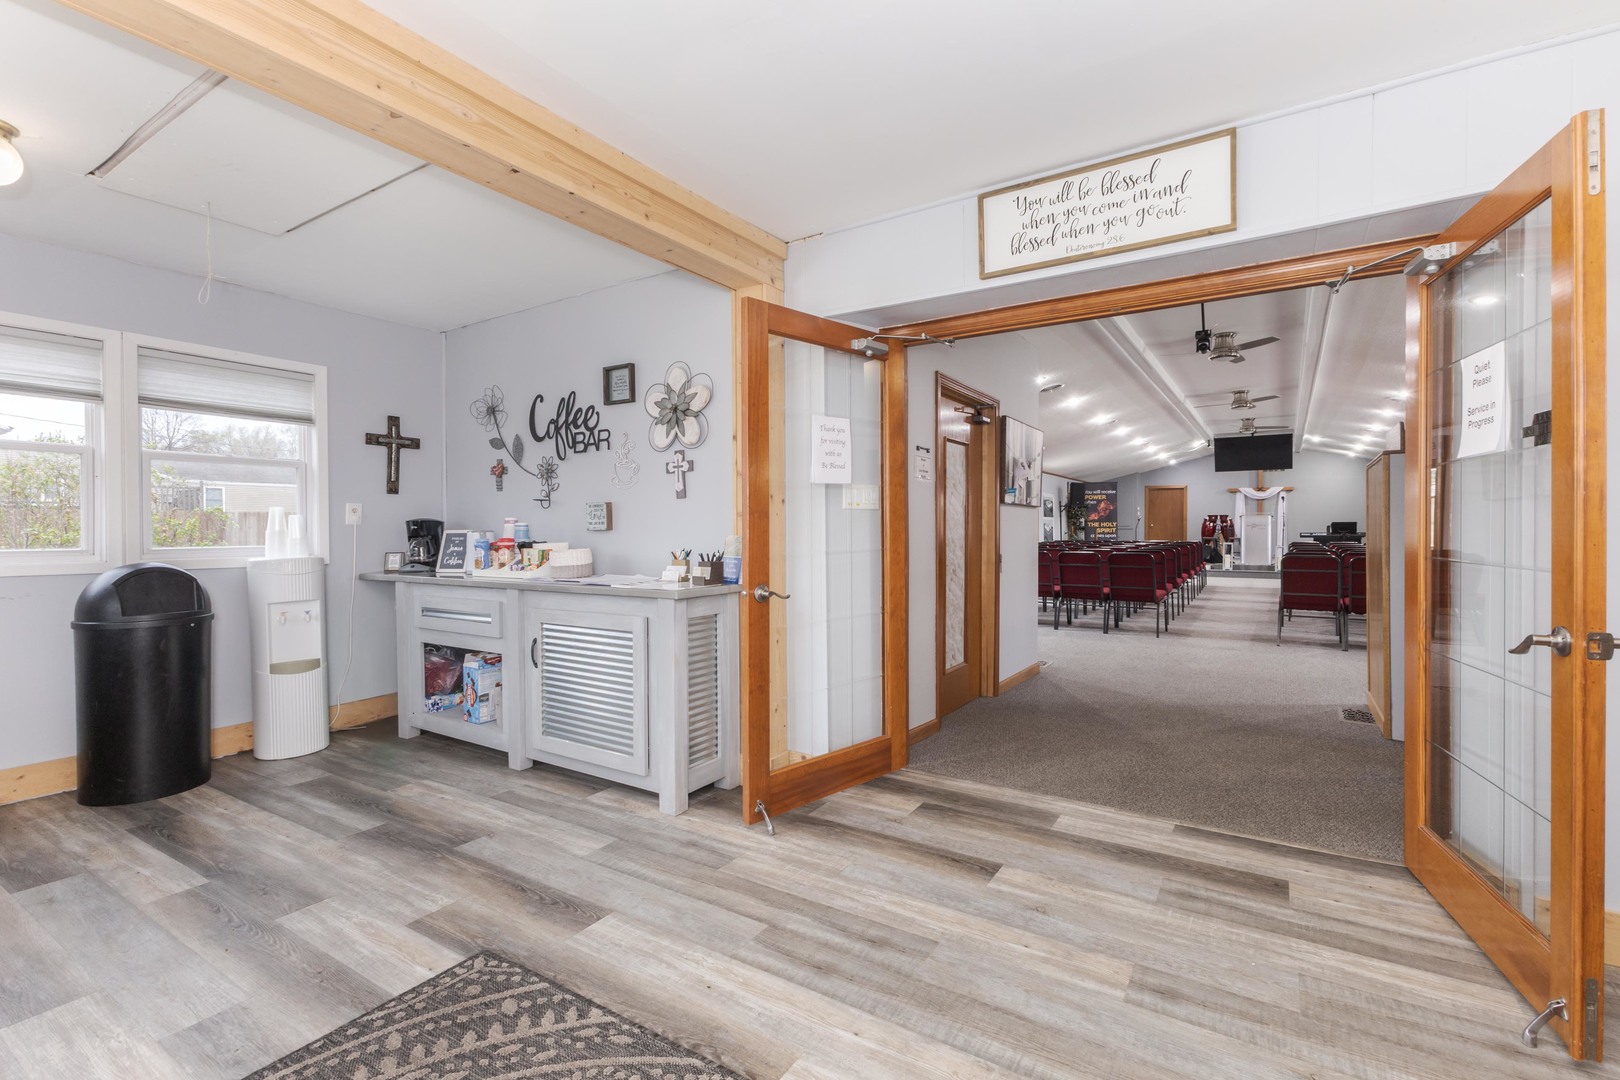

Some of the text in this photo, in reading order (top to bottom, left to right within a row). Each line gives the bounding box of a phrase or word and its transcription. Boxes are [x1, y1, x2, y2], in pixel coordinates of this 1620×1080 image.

[1013, 158, 1161, 216] You will be blessed
[1022, 170, 1192, 231] when you come in and
[1010, 196, 1192, 256] blessed when you go out.
[1474, 361, 1491, 375] Quiet
[1472, 375, 1492, 389] Please
[1467, 401, 1496, 417] Service in
[529, 391, 600, 461] Coffee
[1467, 415, 1495, 430] Progress
[819, 424, 846, 437] Thank you
[574, 429, 611, 454] BAR
[819, 436, 847, 448] for visiting
[825, 449, 836, 457] with
[829, 461, 847, 470] Blessed
[443, 556, 463, 566] Coffee
